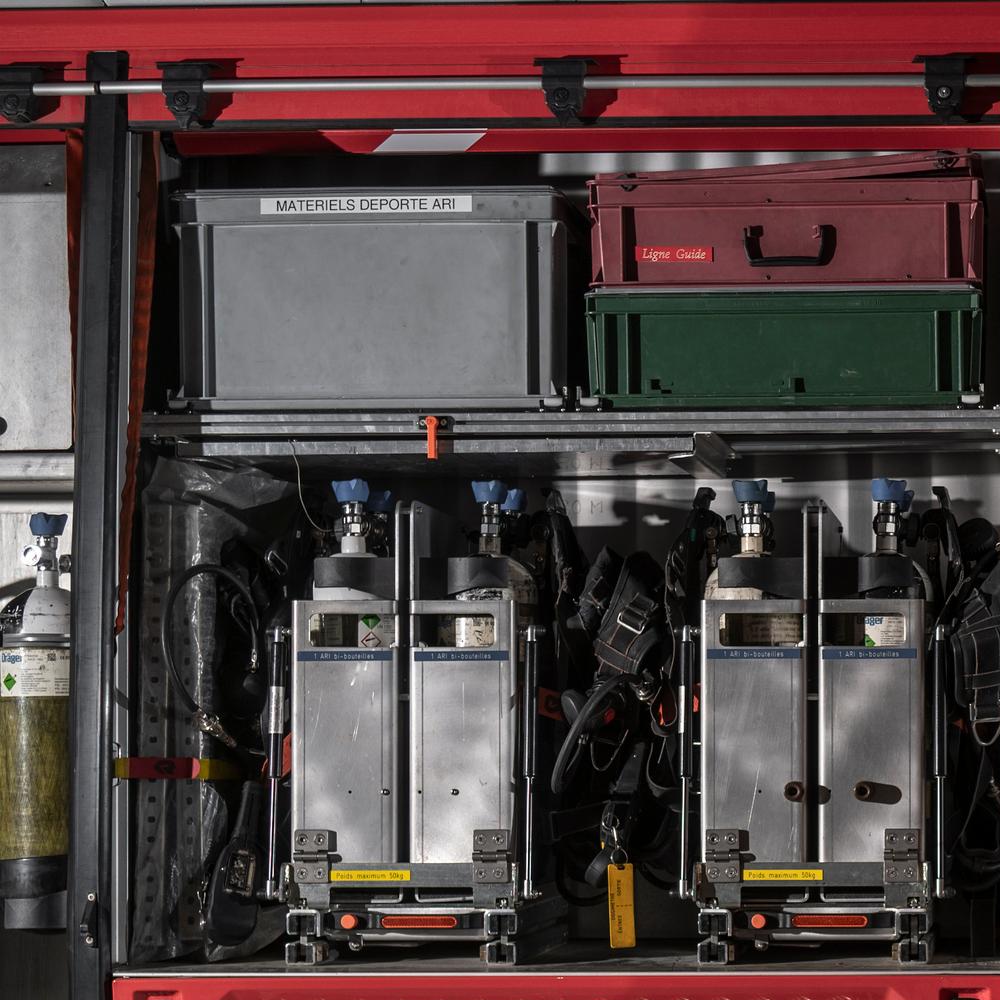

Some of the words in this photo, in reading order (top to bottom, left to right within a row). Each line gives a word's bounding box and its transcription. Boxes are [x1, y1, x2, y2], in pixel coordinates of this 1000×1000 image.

[276, 199, 355, 212] MATERIELS
[360, 198, 428, 211] DEPORTE
[432, 197, 456, 210] ARI
[642, 248, 671, 262] Ligne
[676, 248, 706, 260] Guide
[333, 652, 374, 660] bi-bouteilles
[450, 652, 491, 660] bi-bouteilles
[743, 650, 784, 658] bi-bouteilles
[859, 650, 899, 658] bi-bouteilles
[336, 872, 353, 880] Poids
[356, 872, 387, 880] maximum
[389, 872, 404, 880] 50kg
[748, 871, 765, 879] Poids
[801, 871, 816, 880] 50kg
